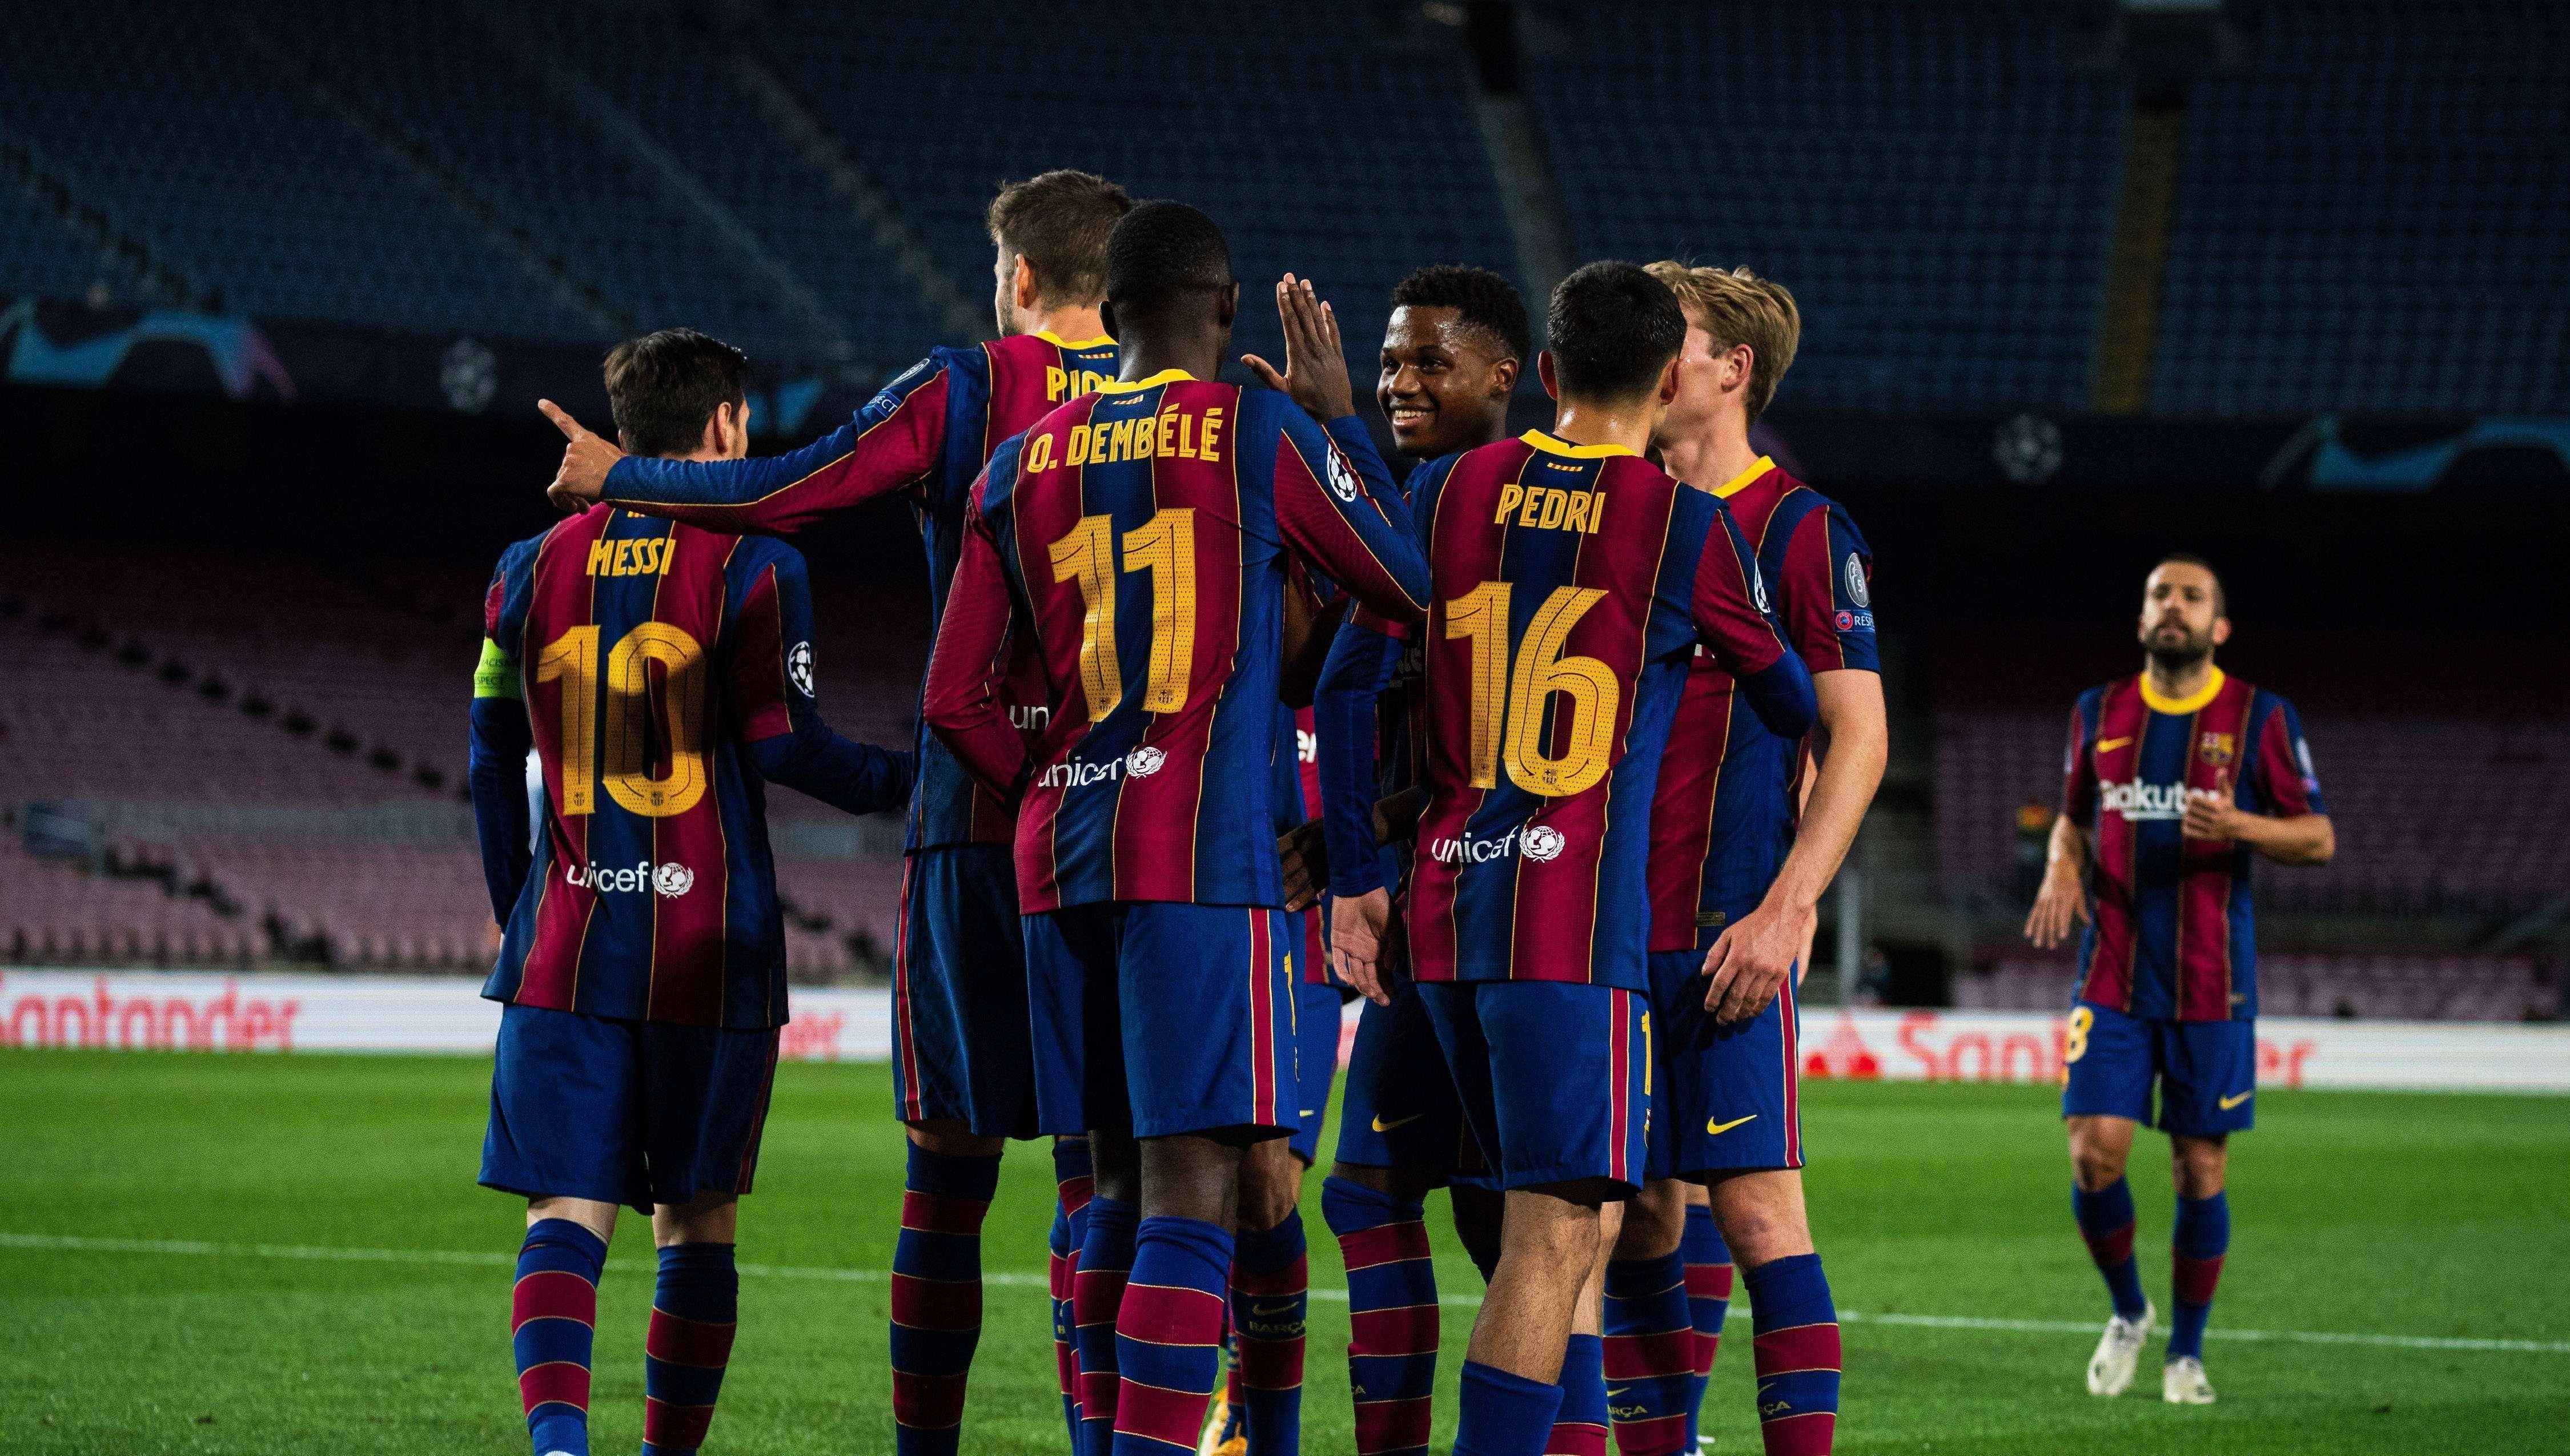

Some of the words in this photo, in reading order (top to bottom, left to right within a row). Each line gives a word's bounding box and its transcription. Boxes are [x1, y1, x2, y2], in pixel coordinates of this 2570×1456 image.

[1046, 365, 1116, 402] PIQ
[1027, 433, 1058, 473] O.
[1065, 403, 1223, 466] DEMBÉLÉ
[1494, 484, 1607, 534] PEDRI
[586, 537, 677, 577] MESSI
[1047, 508, 1196, 722] 11
[1854, 616, 1874, 628] RESP
[537, 621, 707, 817] 10
[1445, 581, 1620, 797] 16
[0, 974, 304, 1051] antander
